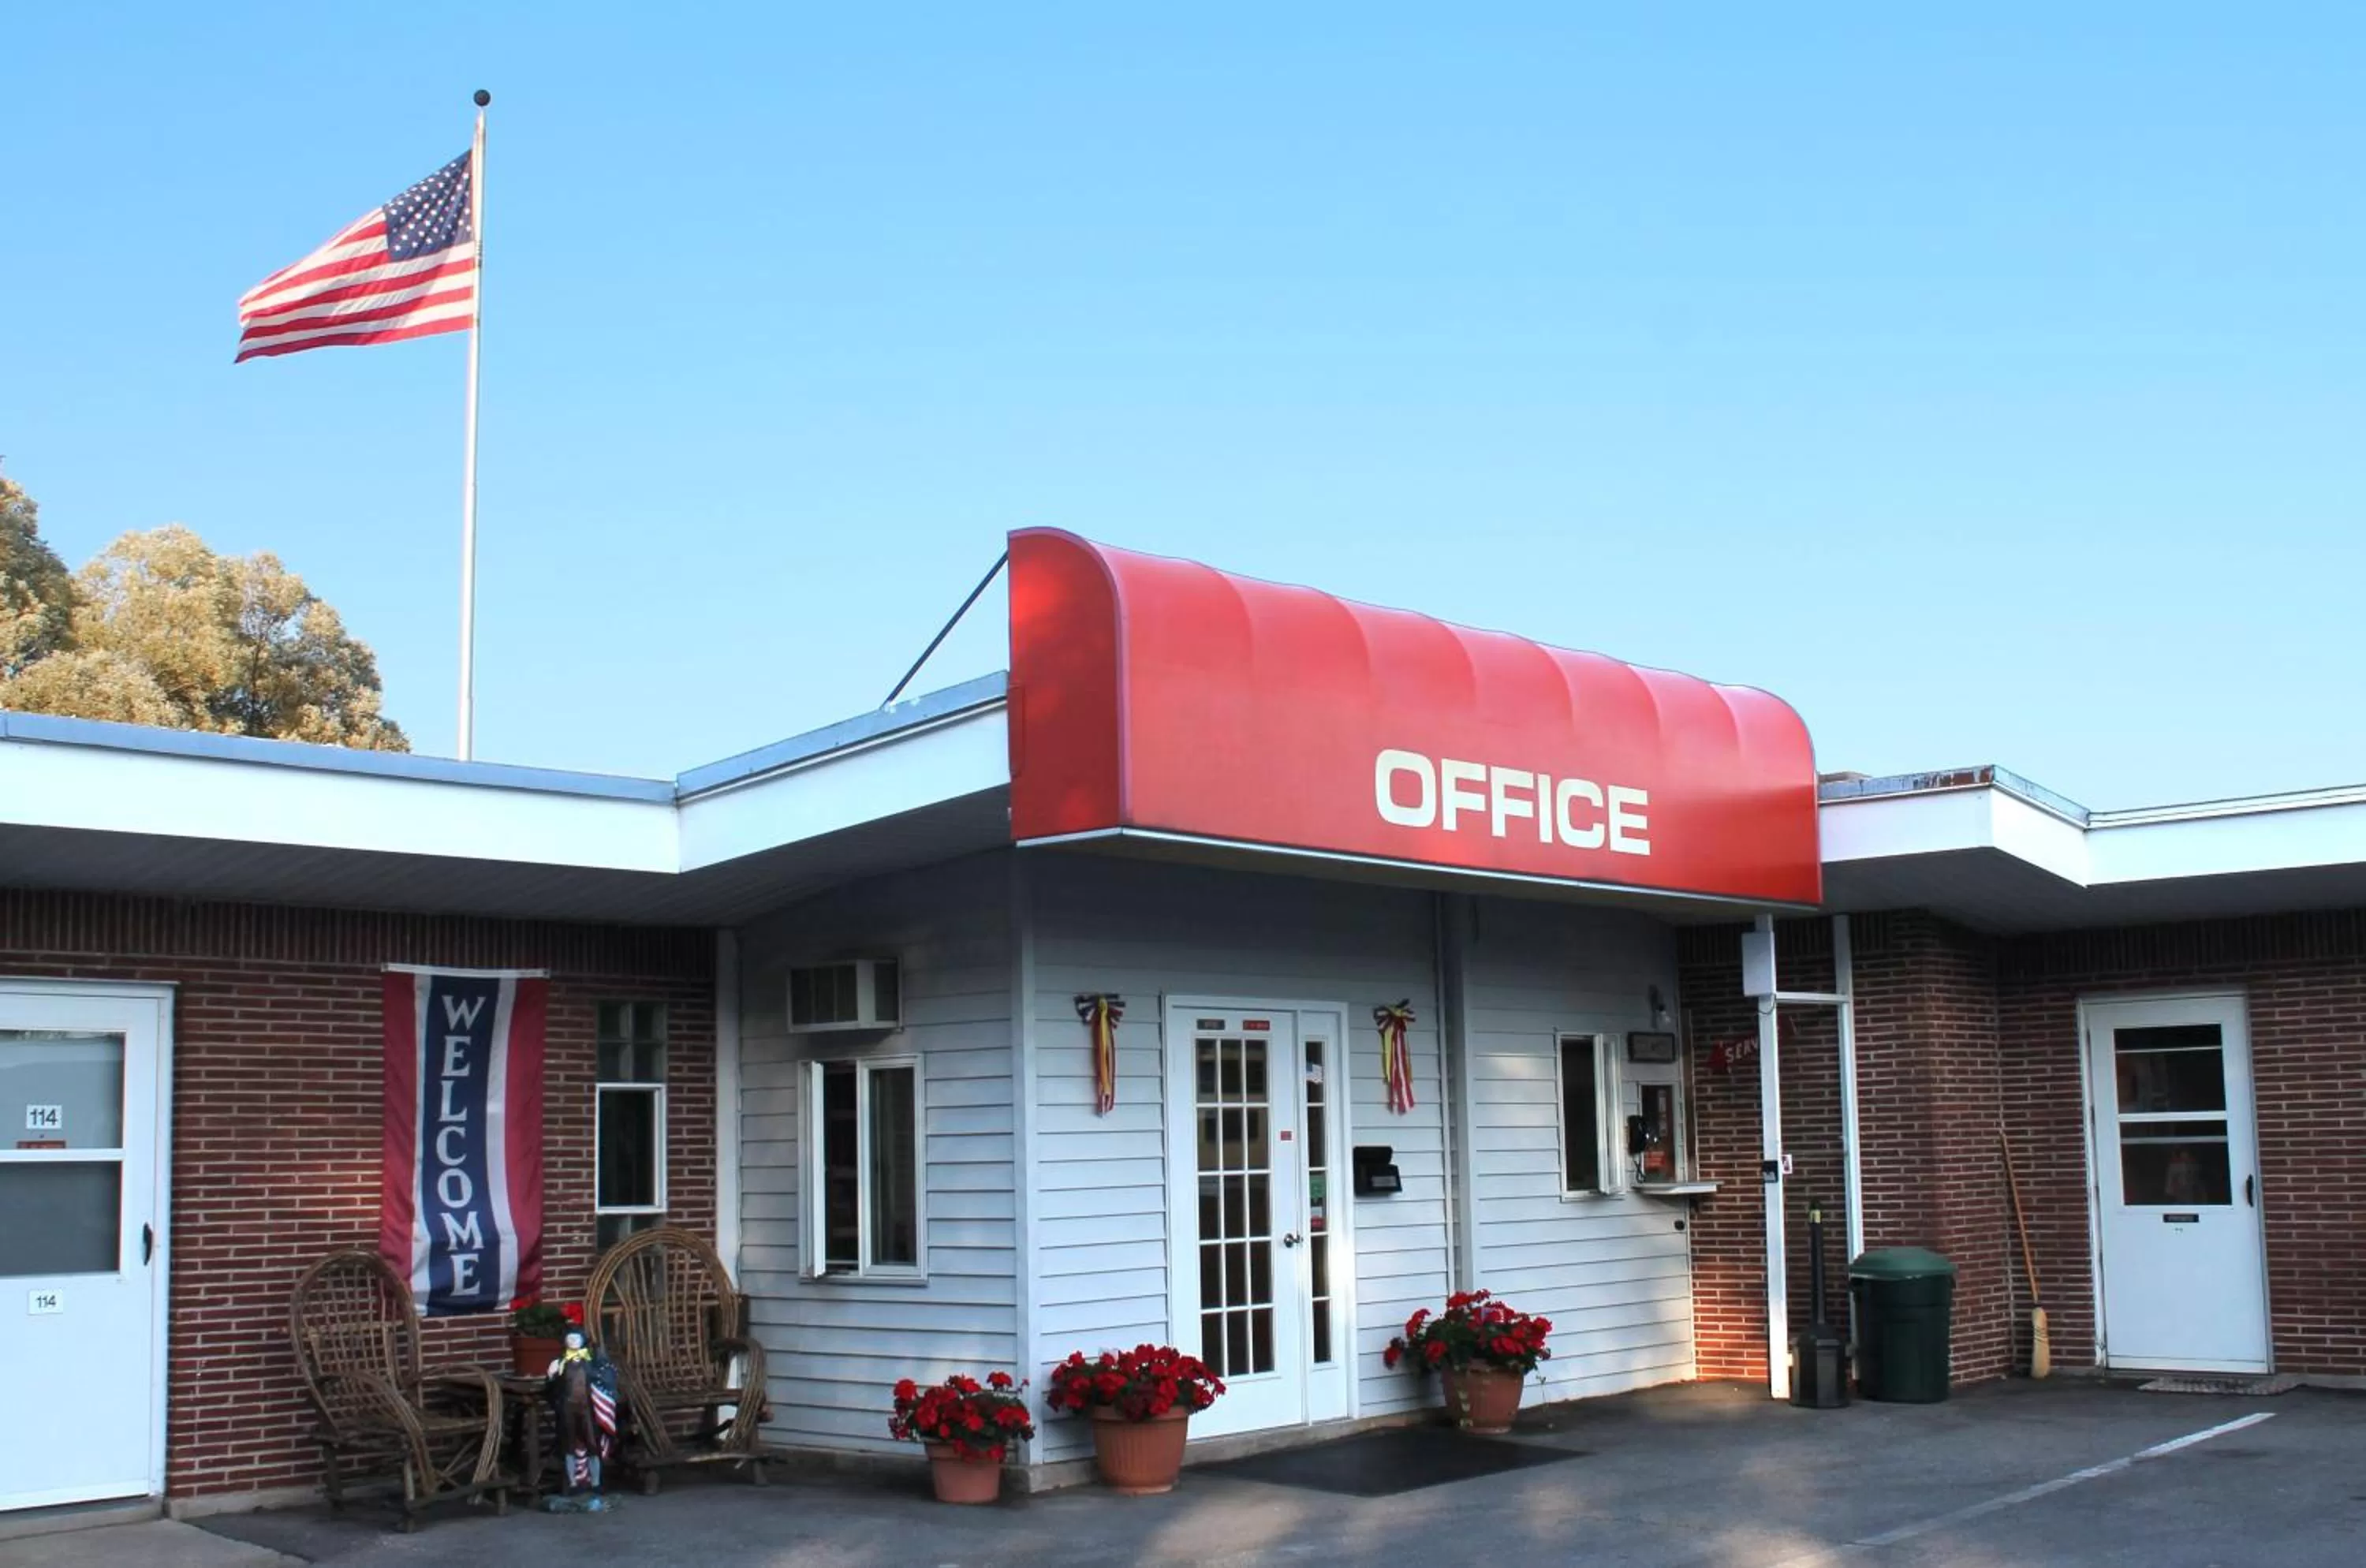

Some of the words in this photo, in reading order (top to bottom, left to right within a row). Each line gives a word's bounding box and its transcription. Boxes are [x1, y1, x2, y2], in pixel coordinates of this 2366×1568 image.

[1375, 749, 1651, 856] OFFICE
[1725, 1036, 1759, 1064] SERV
[29, 1107, 59, 1126] 114
[435, 995, 486, 1297] WELCOME
[35, 1294, 58, 1309] 114
